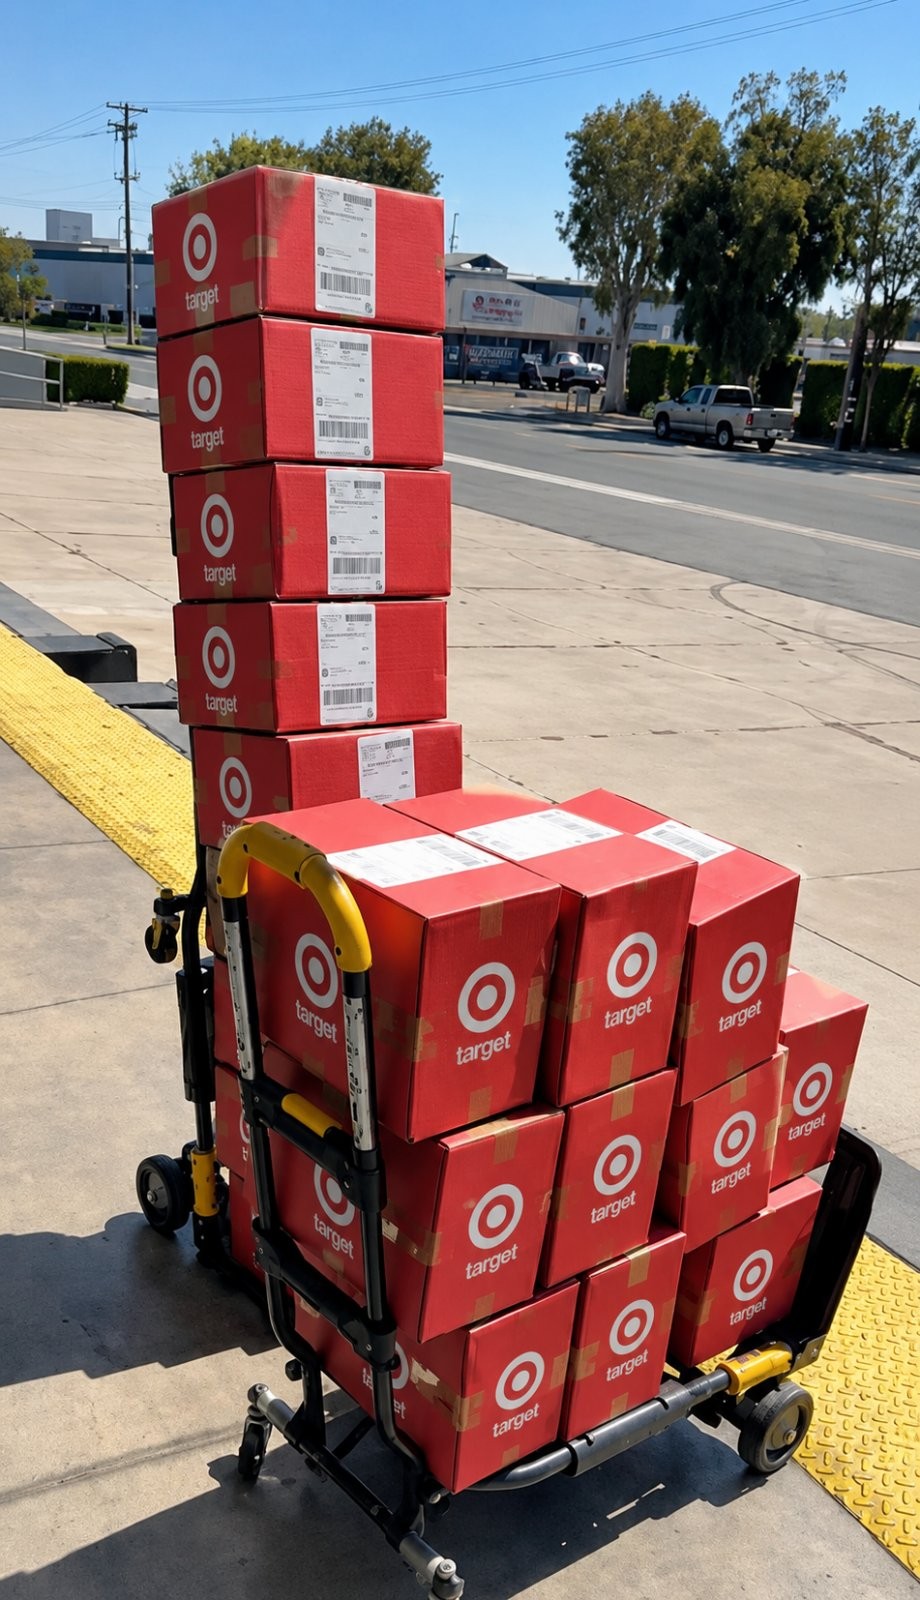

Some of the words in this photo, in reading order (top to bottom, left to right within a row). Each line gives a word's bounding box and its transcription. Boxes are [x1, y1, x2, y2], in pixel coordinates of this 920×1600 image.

[186, 287, 218, 312] target
[191, 427, 224, 452] target
[204, 563, 237, 586] target
[205, 694, 237, 716] target
[295, 1000, 337, 1043] target
[605, 997, 652, 1029] target
[718, 1000, 762, 1032] target
[457, 1032, 511, 1065] target
[788, 1113, 825, 1141] target
[711, 1162, 751, 1194] target
[591, 1190, 636, 1224] target
[314, 1213, 354, 1259] target
[466, 1244, 517, 1279] target
[729, 1297, 767, 1326] target
[606, 1350, 648, 1382] target
[493, 1403, 539, 1437] target
